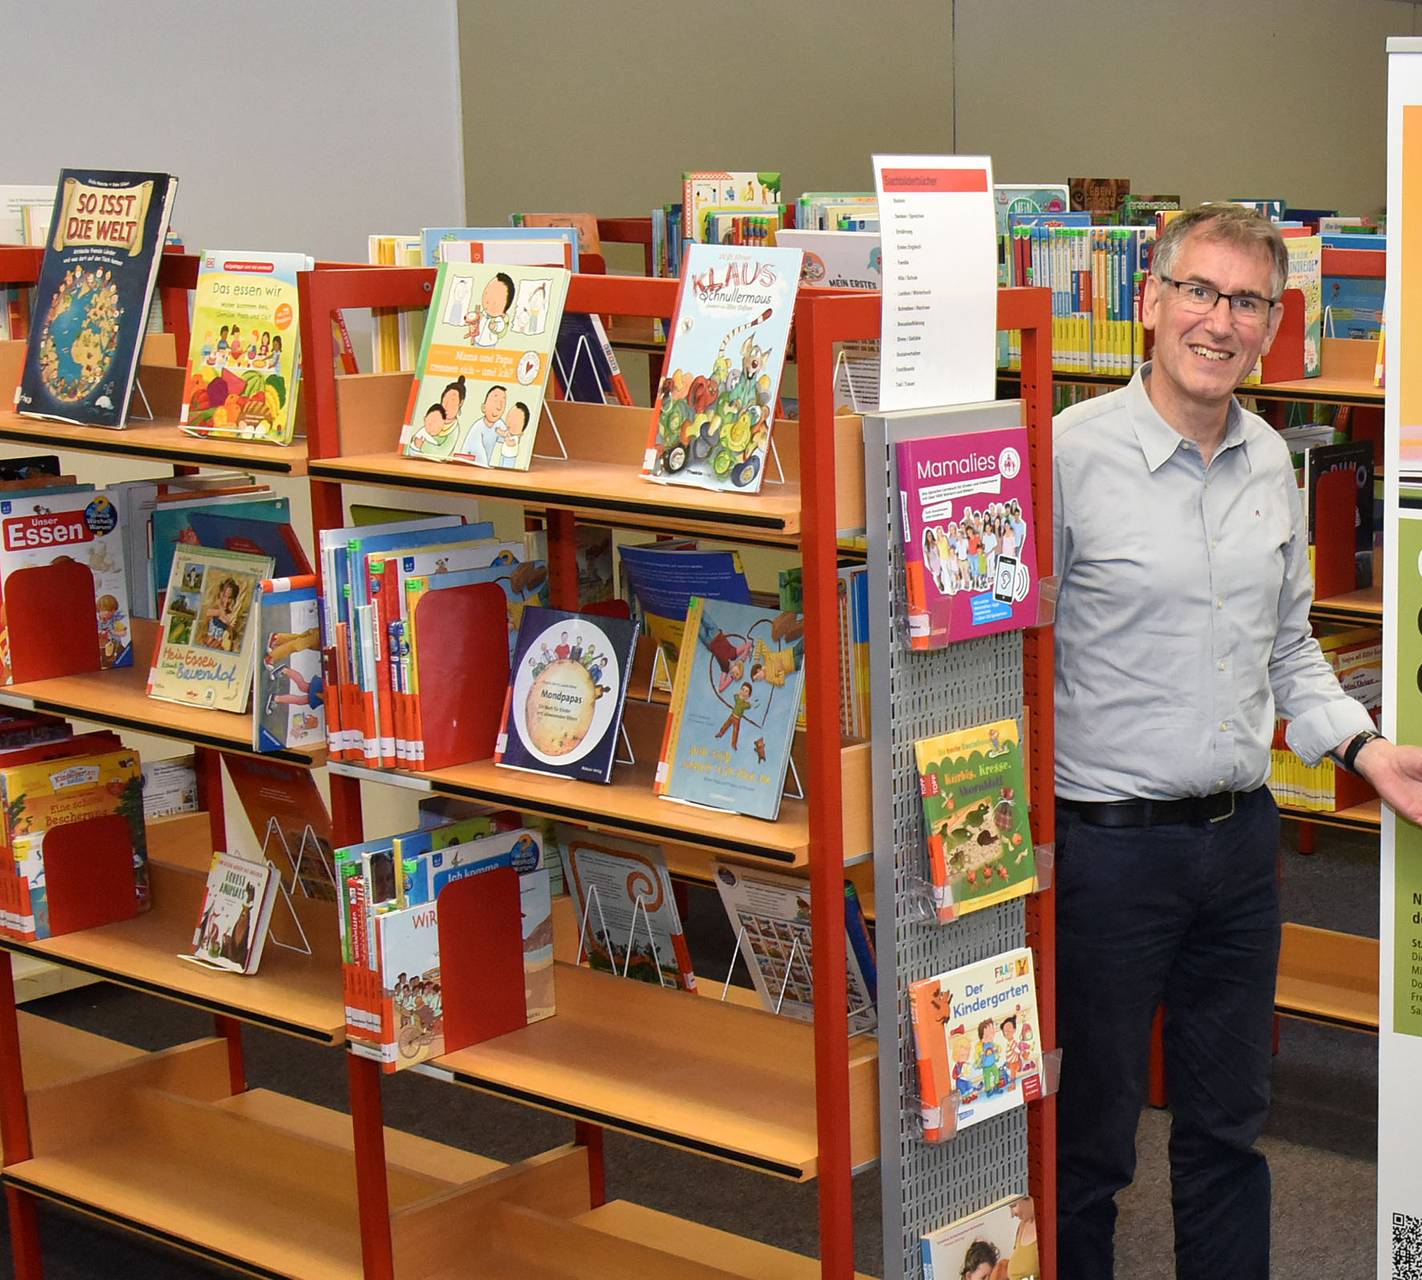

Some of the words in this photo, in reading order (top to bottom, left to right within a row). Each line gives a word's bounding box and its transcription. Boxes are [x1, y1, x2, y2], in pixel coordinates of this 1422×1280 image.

[77, 193, 97, 214] SO
[99, 194, 136, 216] ISST
[67, 217, 94, 240] DIE
[97, 220, 136, 243] WELT
[692, 262, 776, 297] KLAUS
[829, 279, 849, 287] MEIN
[849, 280, 877, 289] ERSTES
[213, 282, 230, 295] Das
[233, 286, 262, 296] essen
[265, 285, 282, 297] wir
[699, 287, 772, 305] Schnullermaus
[917, 452, 996, 479] Mamalies
[32, 517, 58, 526] Unser
[8, 523, 83, 547] Essen
[185, 650, 217, 668] Essen
[541, 689, 582, 704] Mondpapas
[412, 910, 438, 929] WIR
[965, 983, 984, 997] Der
[953, 983, 1029, 1018] Kindergarten
